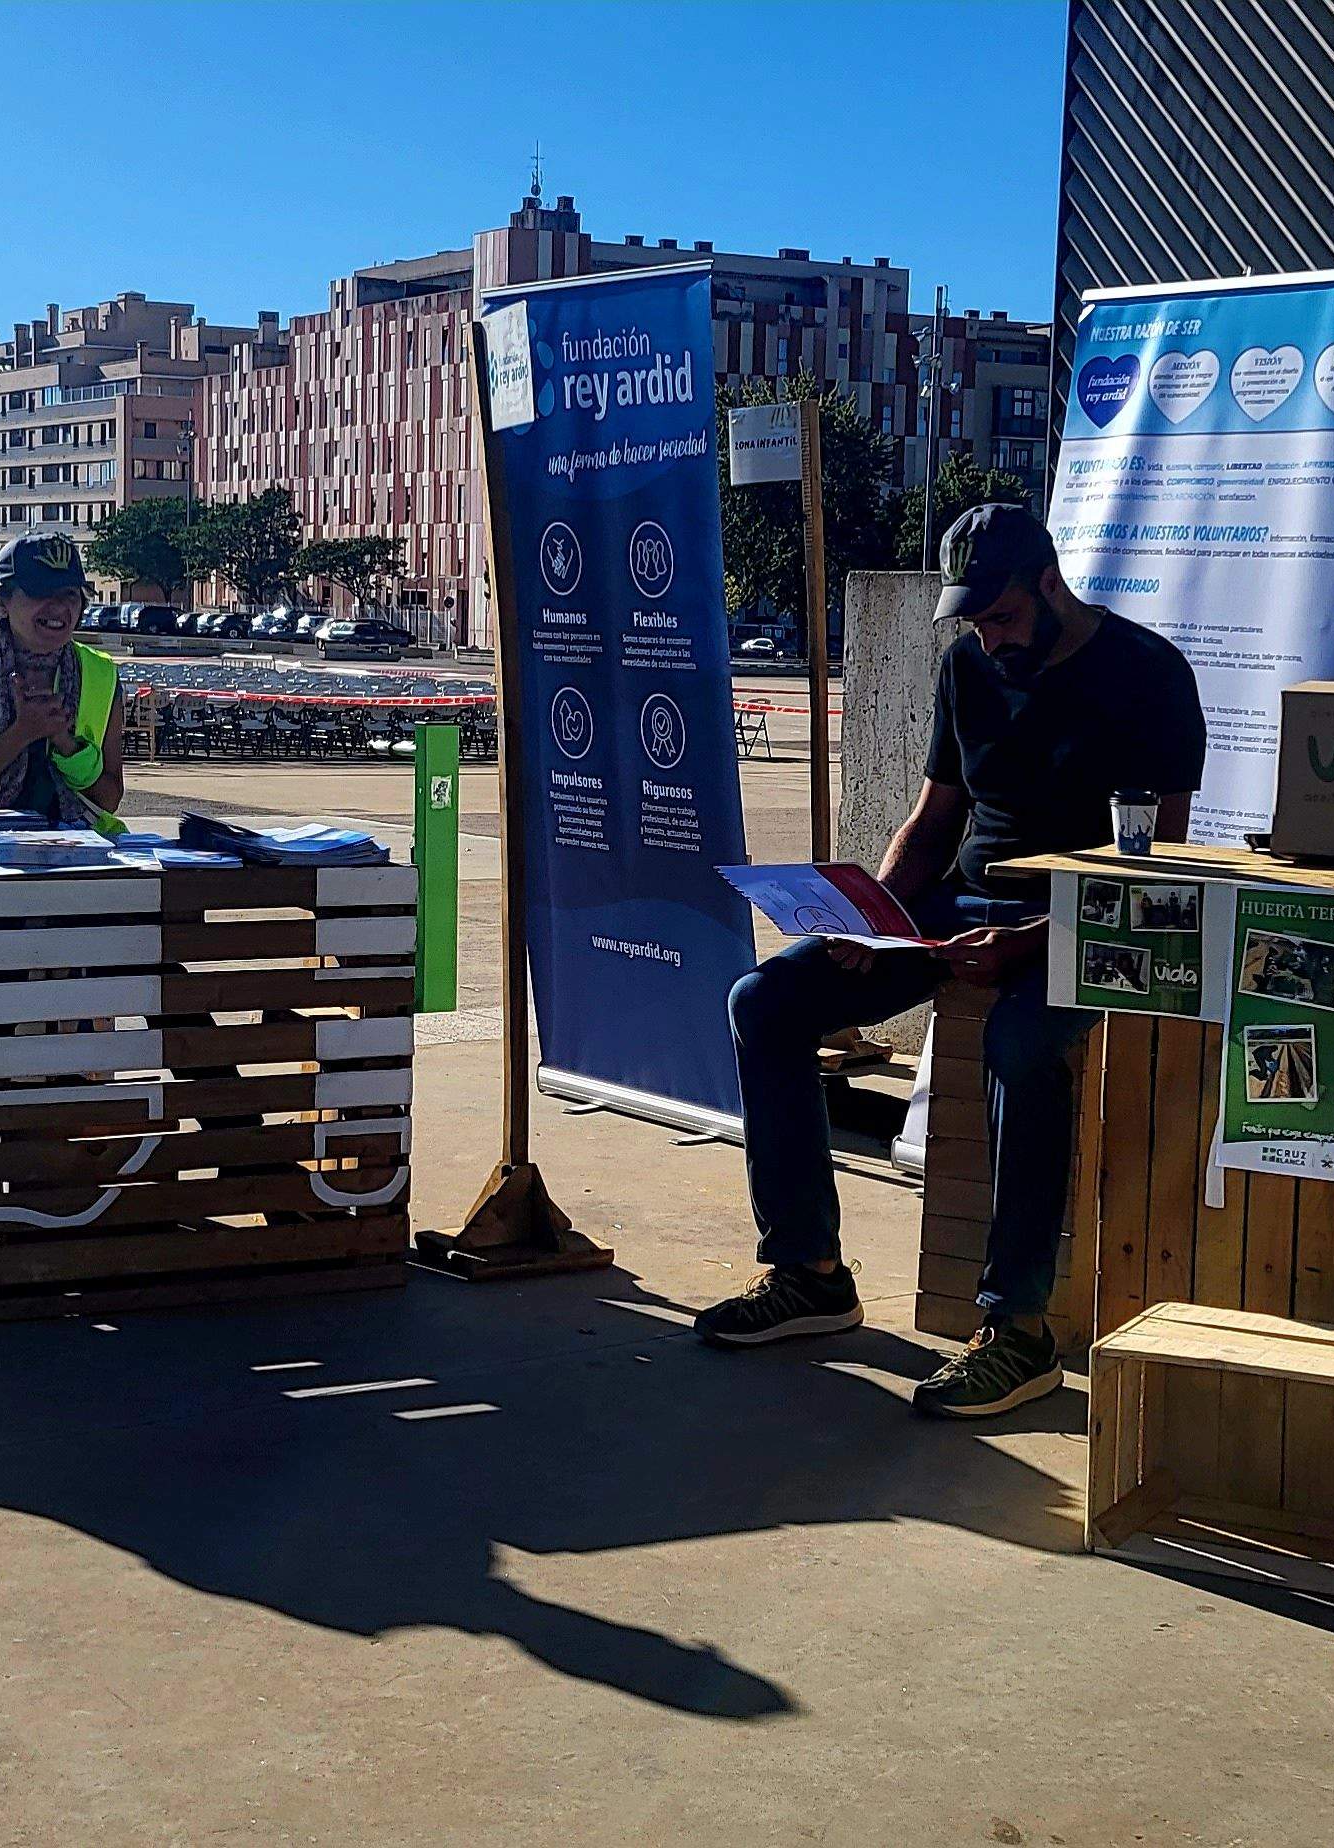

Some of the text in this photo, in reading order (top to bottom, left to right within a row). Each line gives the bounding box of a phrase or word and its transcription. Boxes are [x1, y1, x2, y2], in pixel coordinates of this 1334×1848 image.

[1090, 325, 1133, 342] NUESTRA
[1165, 319, 1181, 336] DE
[1181, 319, 1202, 336] SER
[562, 326, 650, 362] fundación
[563, 350, 693, 420] rey ardid
[1088, 373, 1131, 389] fundación
[1086, 387, 1127, 405] rey ardid
[734, 436, 798, 450] ZONA INFANTIL
[549, 429, 707, 483] una forma de hacer sociedad
[1129, 455, 1146, 471] ES:
[1227, 462, 1262, 471] LIBERTAD
[1130, 524, 1139, 540] A
[1141, 524, 1190, 541] NUESTROS
[1193, 525, 1269, 543] VOLUNTARIOS?
[1087, 576, 1160, 594] VOLUNTARIADO
[542, 608, 588, 625] Humanos
[632, 610, 678, 629] Flexibles
[551, 769, 604, 791] Impulsores
[642, 779, 693, 801] Rigurosos
[1240, 900, 1305, 919] HUERTA
[591, 935, 681, 968] www.reyardid.org
[1154, 962, 1198, 985] vida
[1276, 1148, 1308, 1160] CRUZ
[1276, 1157, 1306, 1167] BLANCA
